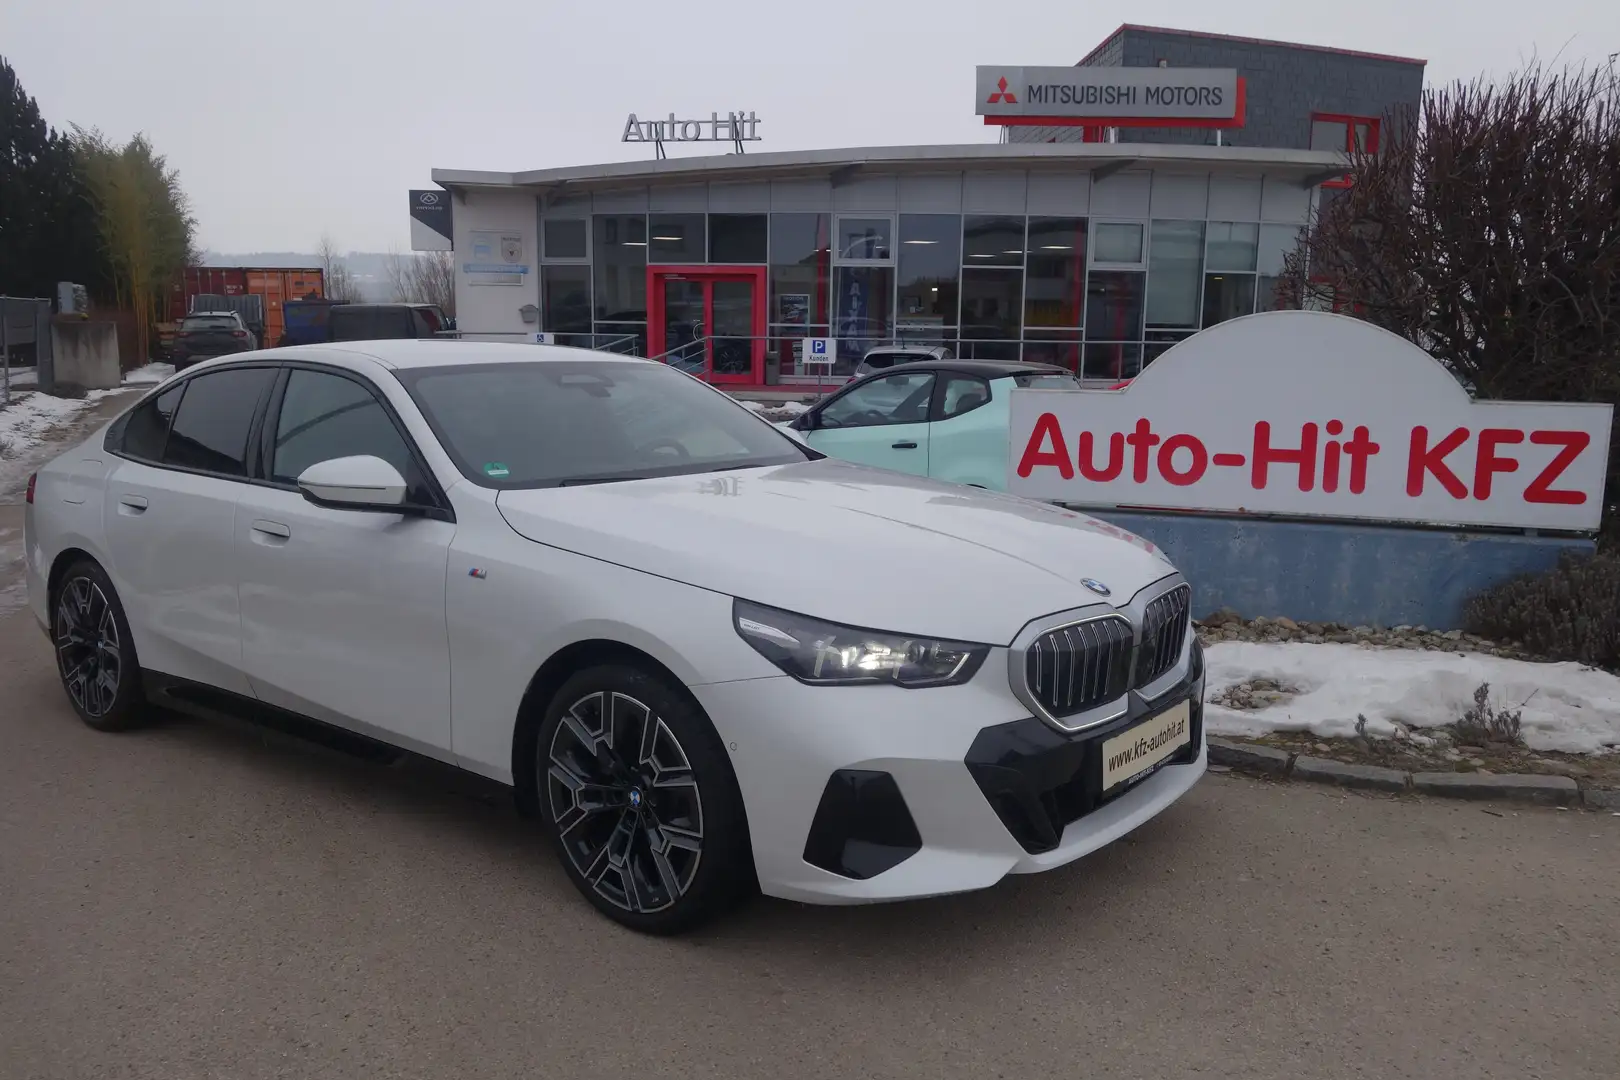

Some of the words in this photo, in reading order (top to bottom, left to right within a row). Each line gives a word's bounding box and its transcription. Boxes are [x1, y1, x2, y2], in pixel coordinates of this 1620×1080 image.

[1027, 84, 1137, 105] MITSUBISHI
[1145, 86, 1223, 106] MOTORS
[621, 112, 701, 142] Auto
[711, 110, 762, 141] Hit
[1017, 412, 1380, 494] Auto-Hit
[1405, 425, 1591, 505] KFZ
[1108, 718, 1185, 772] www.kfz-autohit.at
